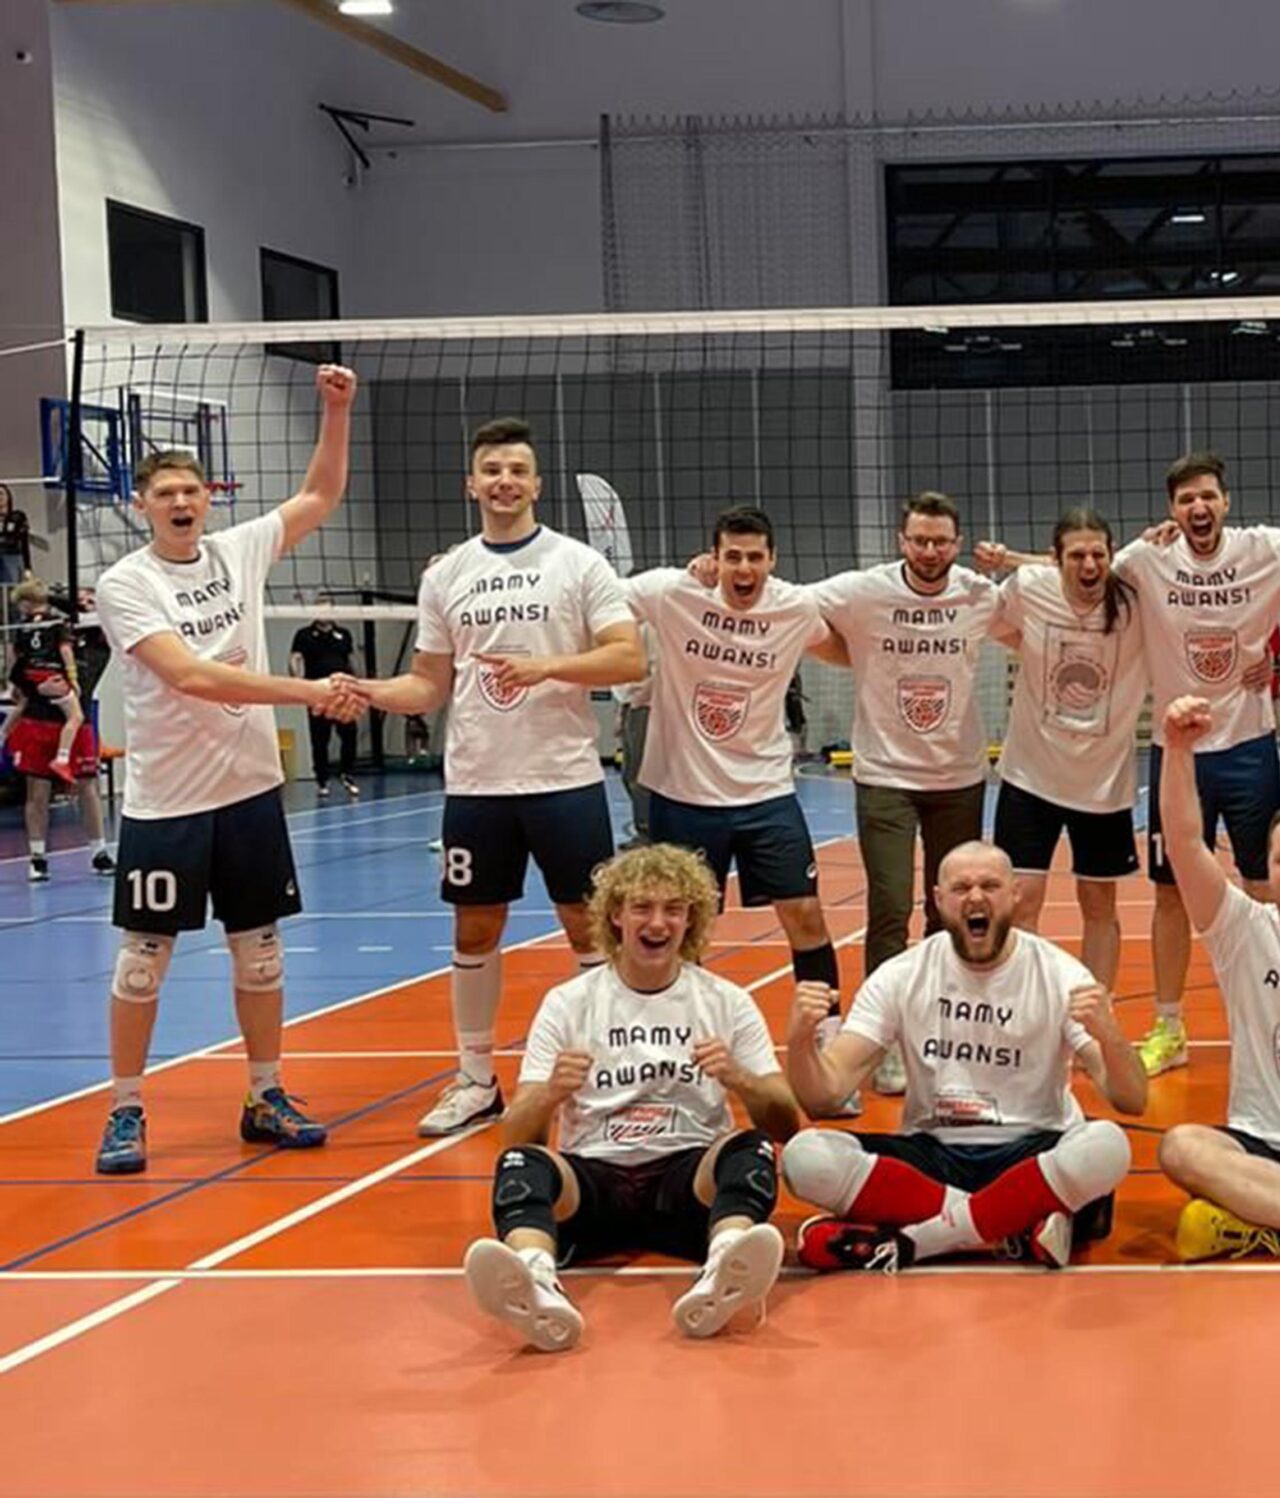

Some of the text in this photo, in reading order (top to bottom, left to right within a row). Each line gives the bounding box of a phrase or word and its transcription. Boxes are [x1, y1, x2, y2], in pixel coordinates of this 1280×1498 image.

[1177, 567, 1236, 586] MAMY
[175, 578, 231, 607] MAMY
[1168, 587, 1251, 606] AWANS!
[460, 604, 549, 627] AWANS!
[702, 611, 770, 637] MAMY
[893, 608, 957, 625] MAMY
[686, 639, 777, 669] AWANS!
[883, 637, 967, 655] AWANS!
[127, 868, 178, 912] 10
[938, 996, 1013, 1027] MAMY
[608, 1025, 692, 1047] MAMY
[596, 1061, 703, 1089] AWANS!
